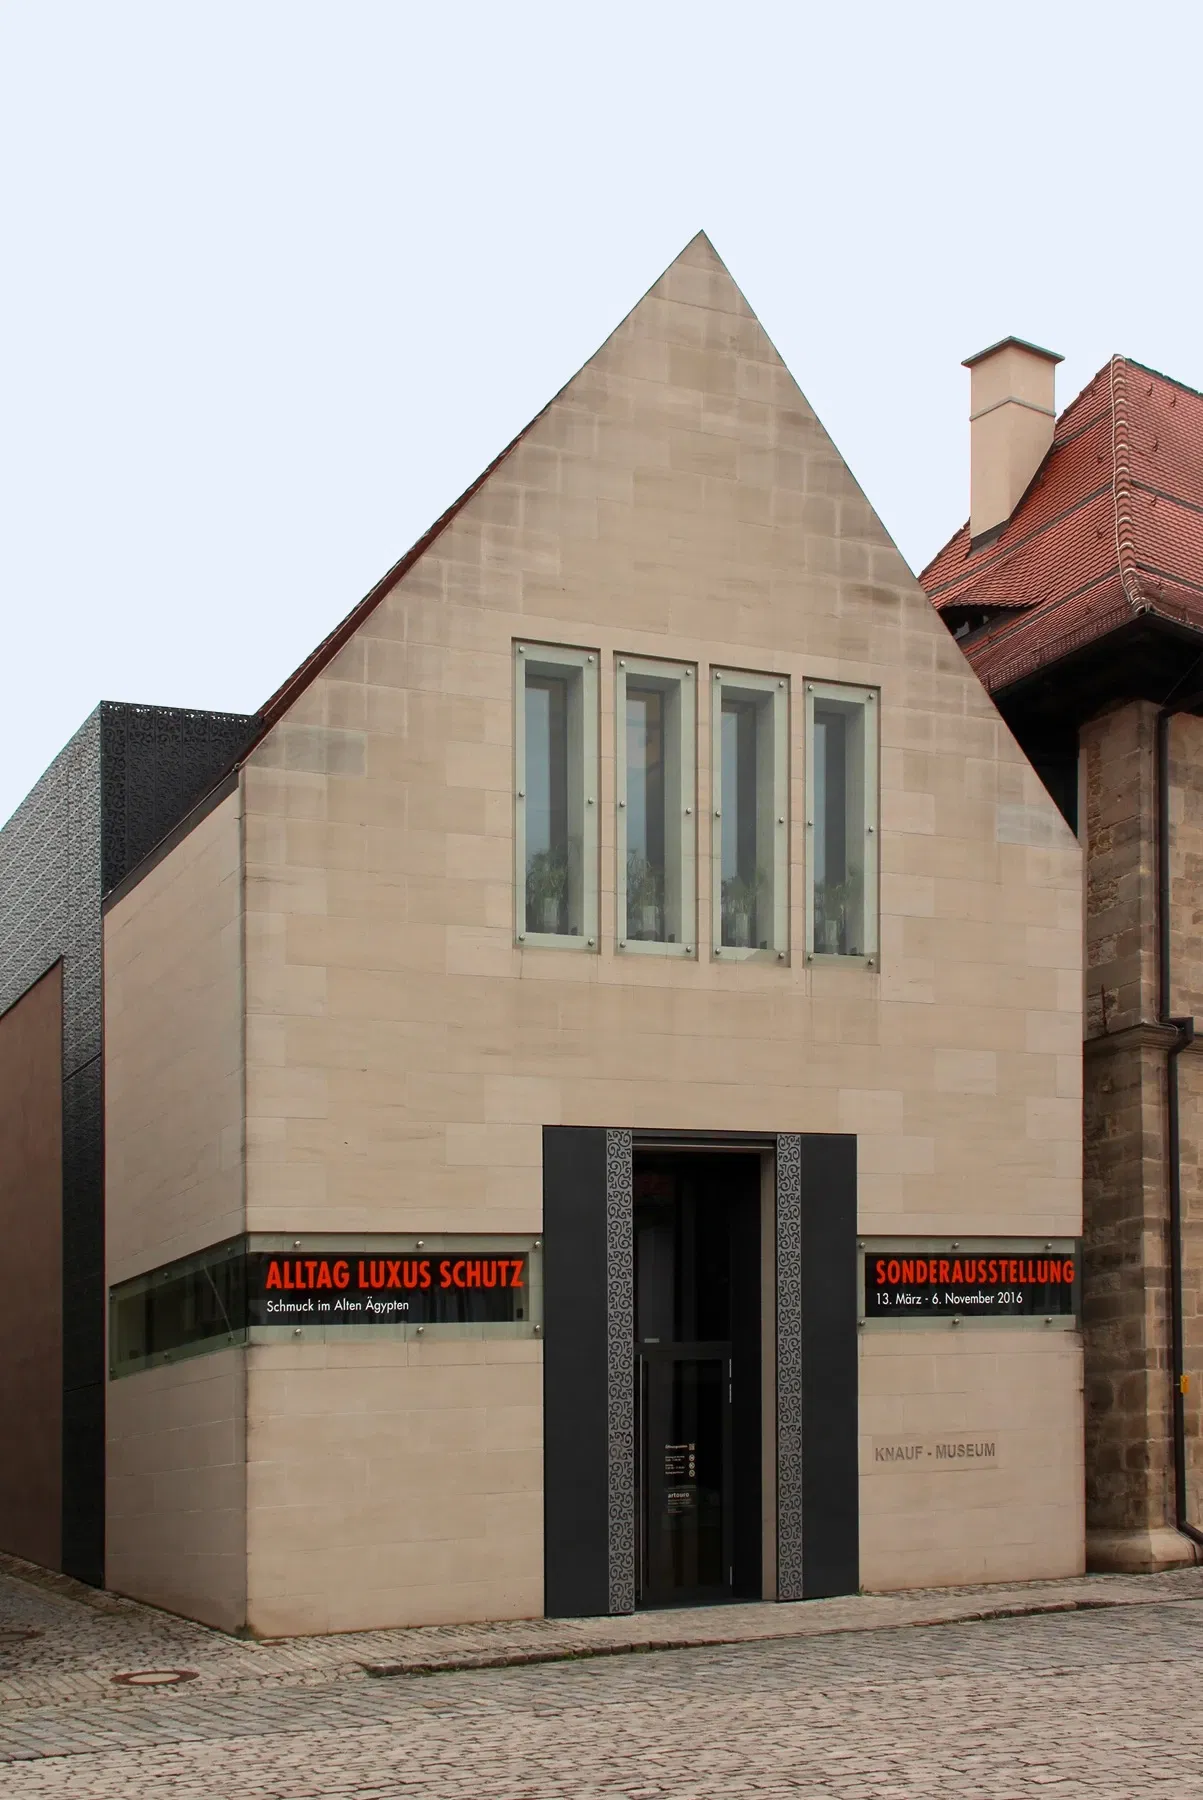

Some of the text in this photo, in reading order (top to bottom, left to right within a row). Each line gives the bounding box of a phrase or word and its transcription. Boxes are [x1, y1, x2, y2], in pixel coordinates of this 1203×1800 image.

[265, 1260, 524, 1289] ALLTAG LUXUS SCHUTZ
[876, 1259, 1075, 1284] SONDERAUSSTELLUNG
[267, 1296, 409, 1314] Schmuck im Alten Ägypten
[876, 1292, 892, 1305] 13.
[895, 1293, 922, 1305] März
[932, 1292, 942, 1305] 6.
[945, 1291, 995, 1304] November
[997, 1291, 1023, 1304] 2016
[875, 1445, 923, 1461] KNAUF
[936, 1443, 995, 1459] MUSEUM
